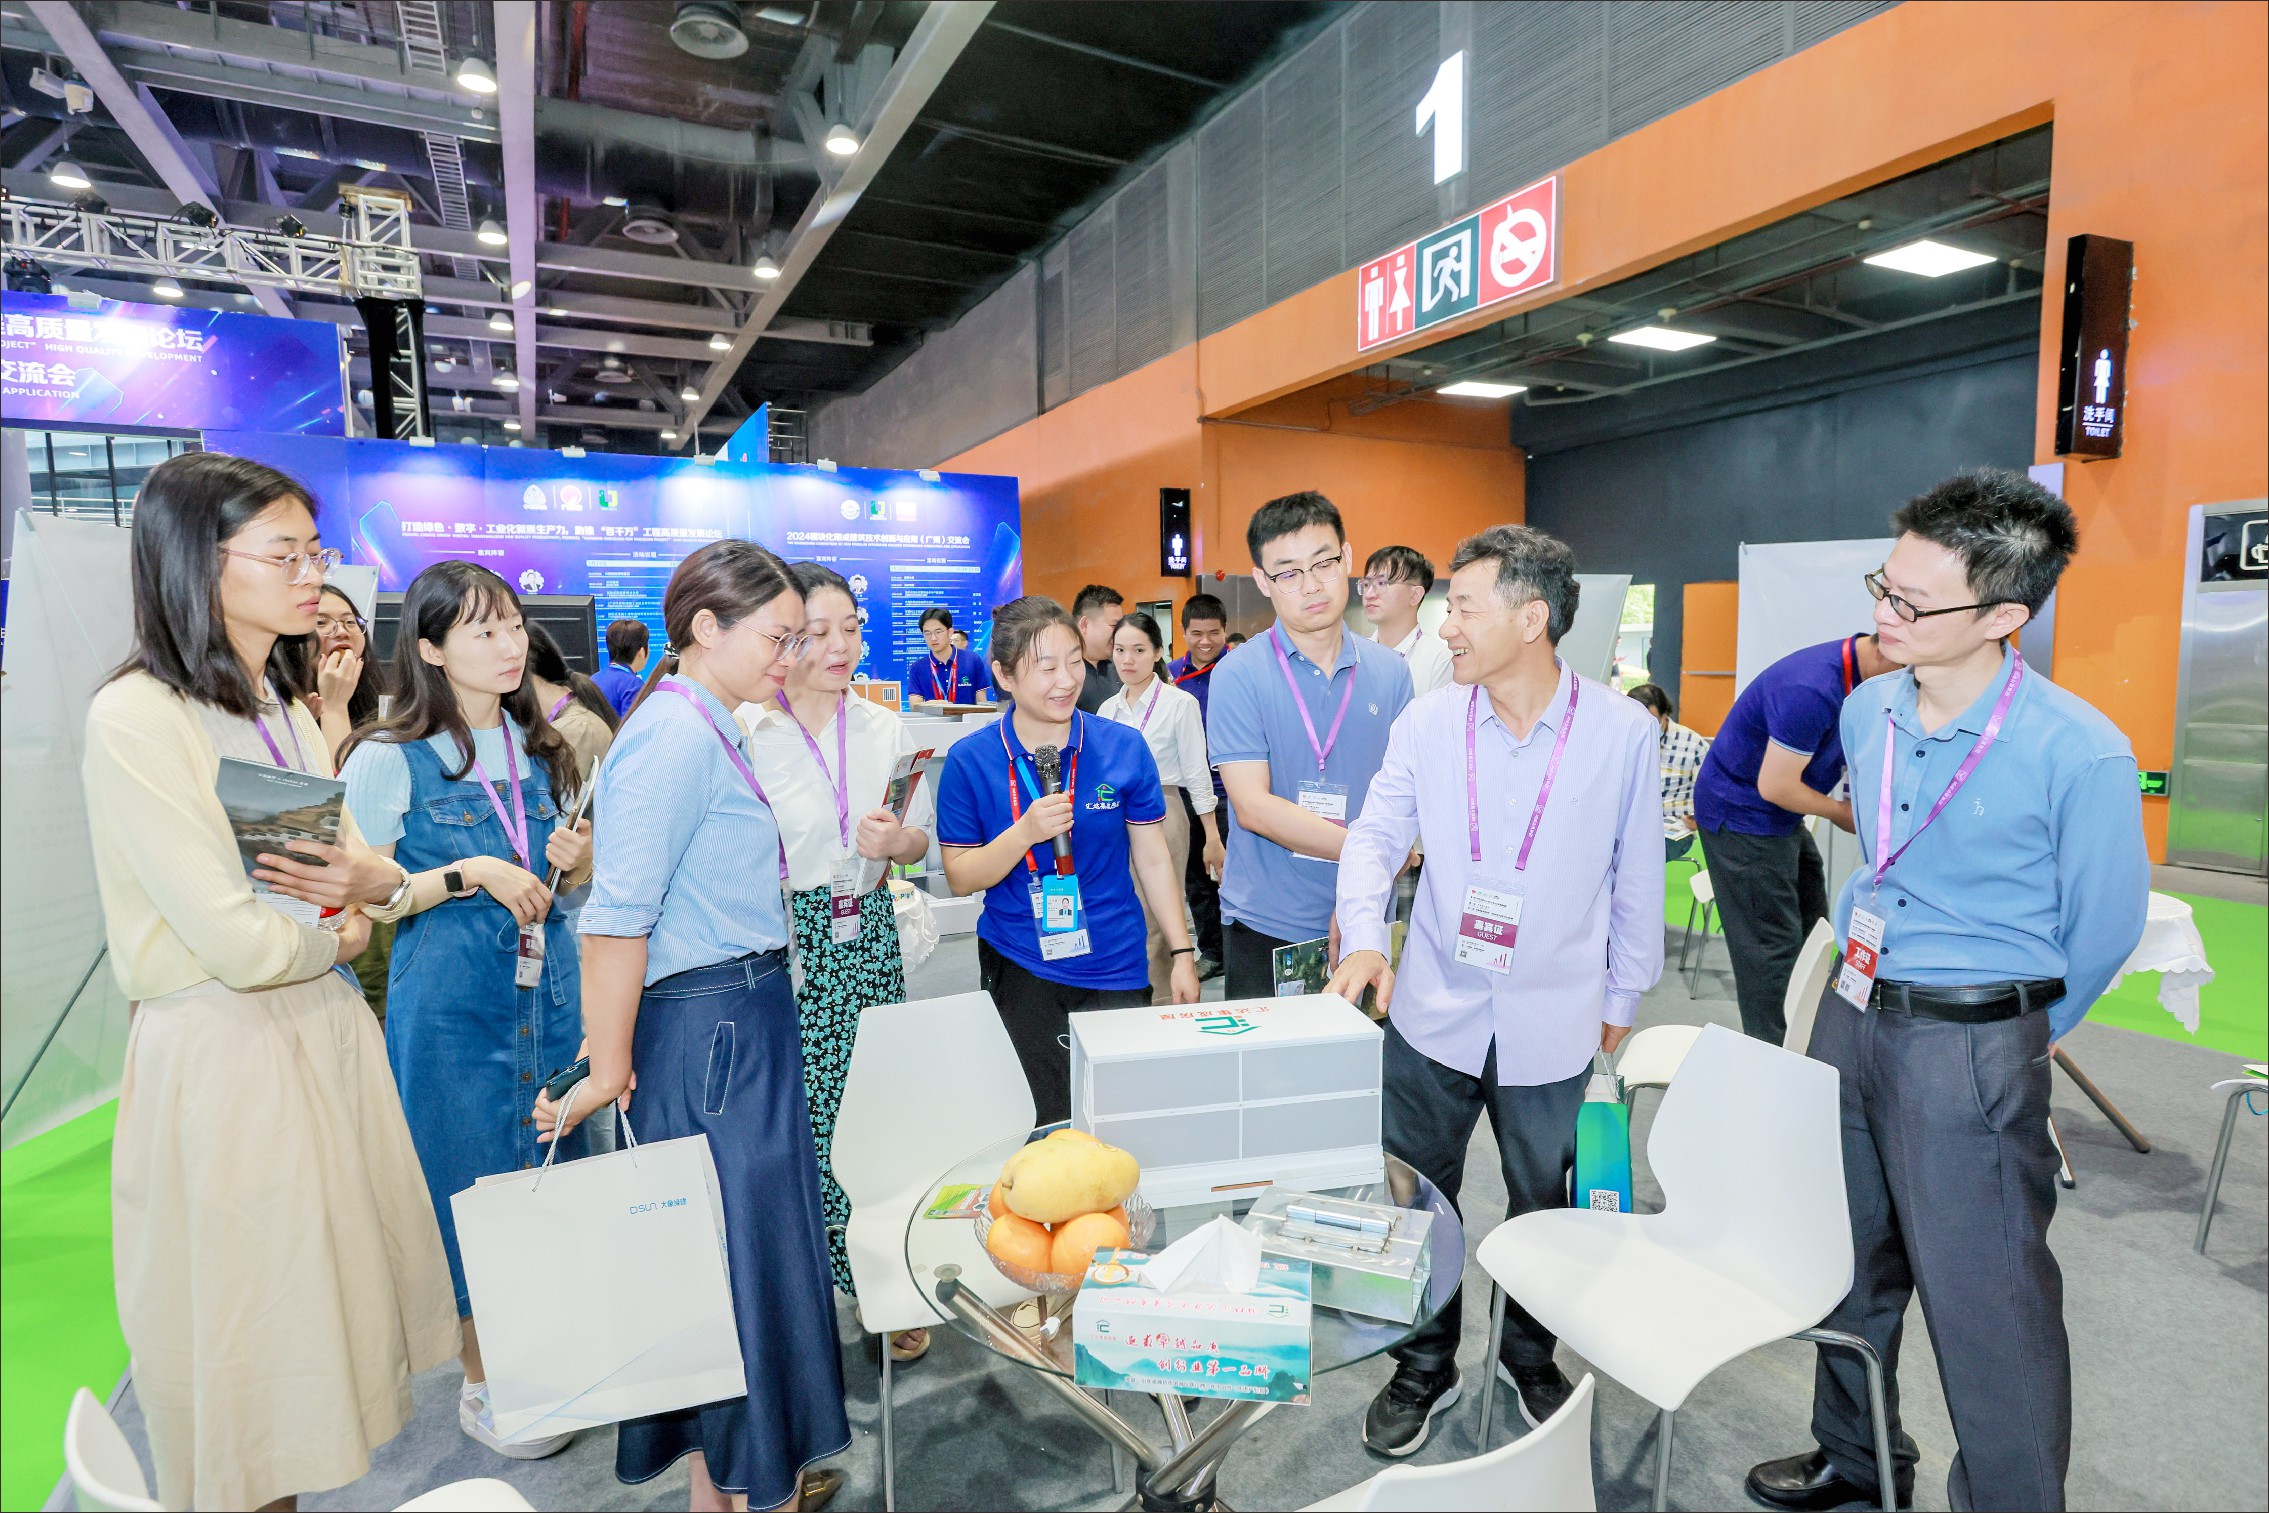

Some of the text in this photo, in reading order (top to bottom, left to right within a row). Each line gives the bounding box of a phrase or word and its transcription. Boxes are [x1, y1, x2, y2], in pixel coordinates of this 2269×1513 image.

[1416, 49, 1464, 185] 1
[45, 343, 73, 353] HIGH
[76, 346, 124, 357] QUALITY
[127, 350, 203, 363] VELOPMENT
[1, 359, 76, 386] 交流会
[3, 387, 80, 399] APPLICATION
[2083, 406, 2115, 423] 洗手间
[2085, 427, 2110, 437] TOILET
[1474, 919, 1503, 935] 嘉宾证
[1477, 931, 1498, 942] GUEST
